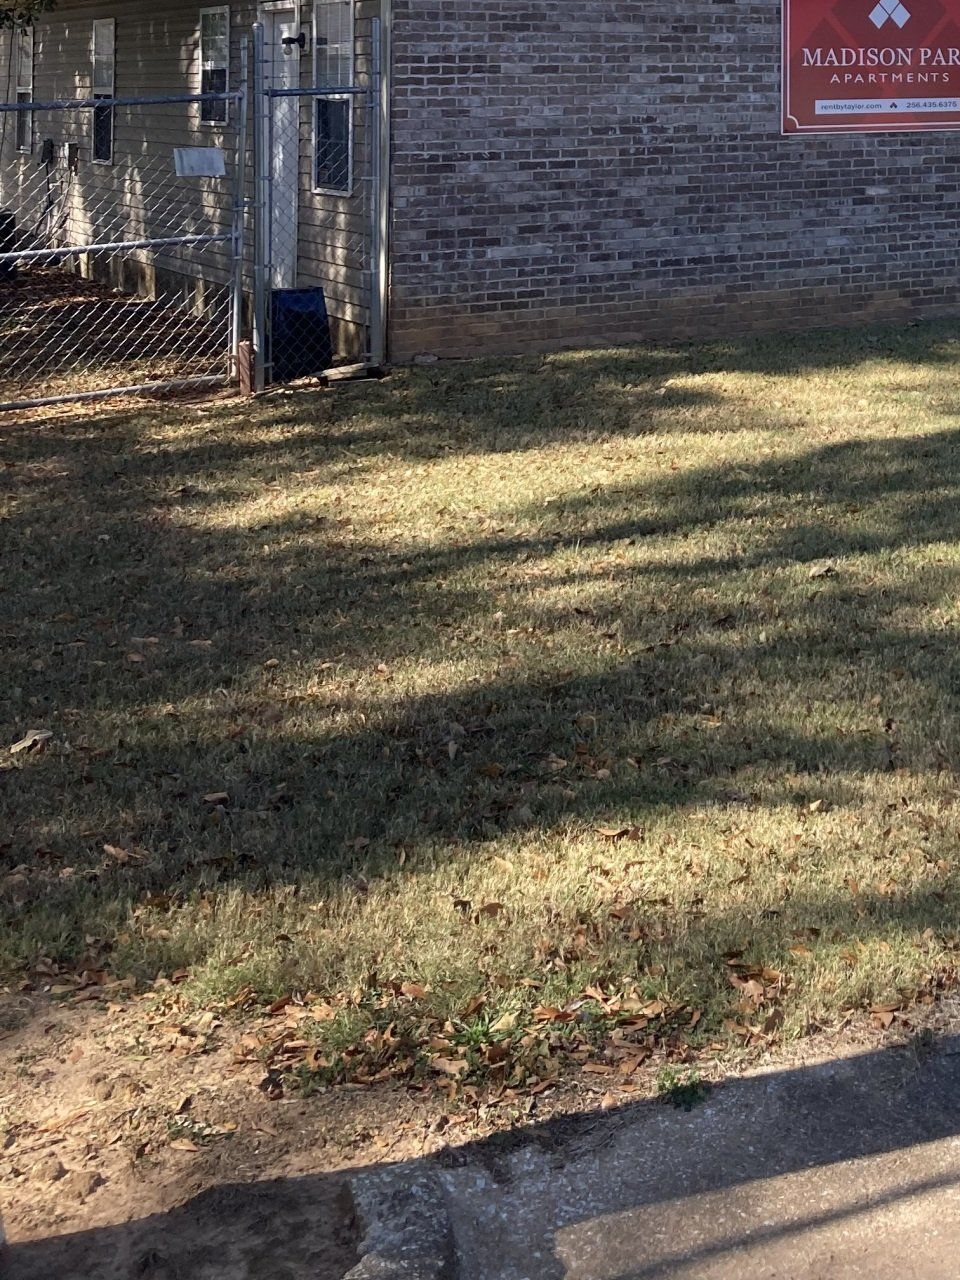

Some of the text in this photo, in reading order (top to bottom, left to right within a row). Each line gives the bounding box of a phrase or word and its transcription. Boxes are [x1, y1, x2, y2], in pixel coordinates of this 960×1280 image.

[801, 47, 914, 67] MADISON
[830, 72, 950, 84] APARTMENTS
[820, 102, 882, 111] rentbytaylor.com
